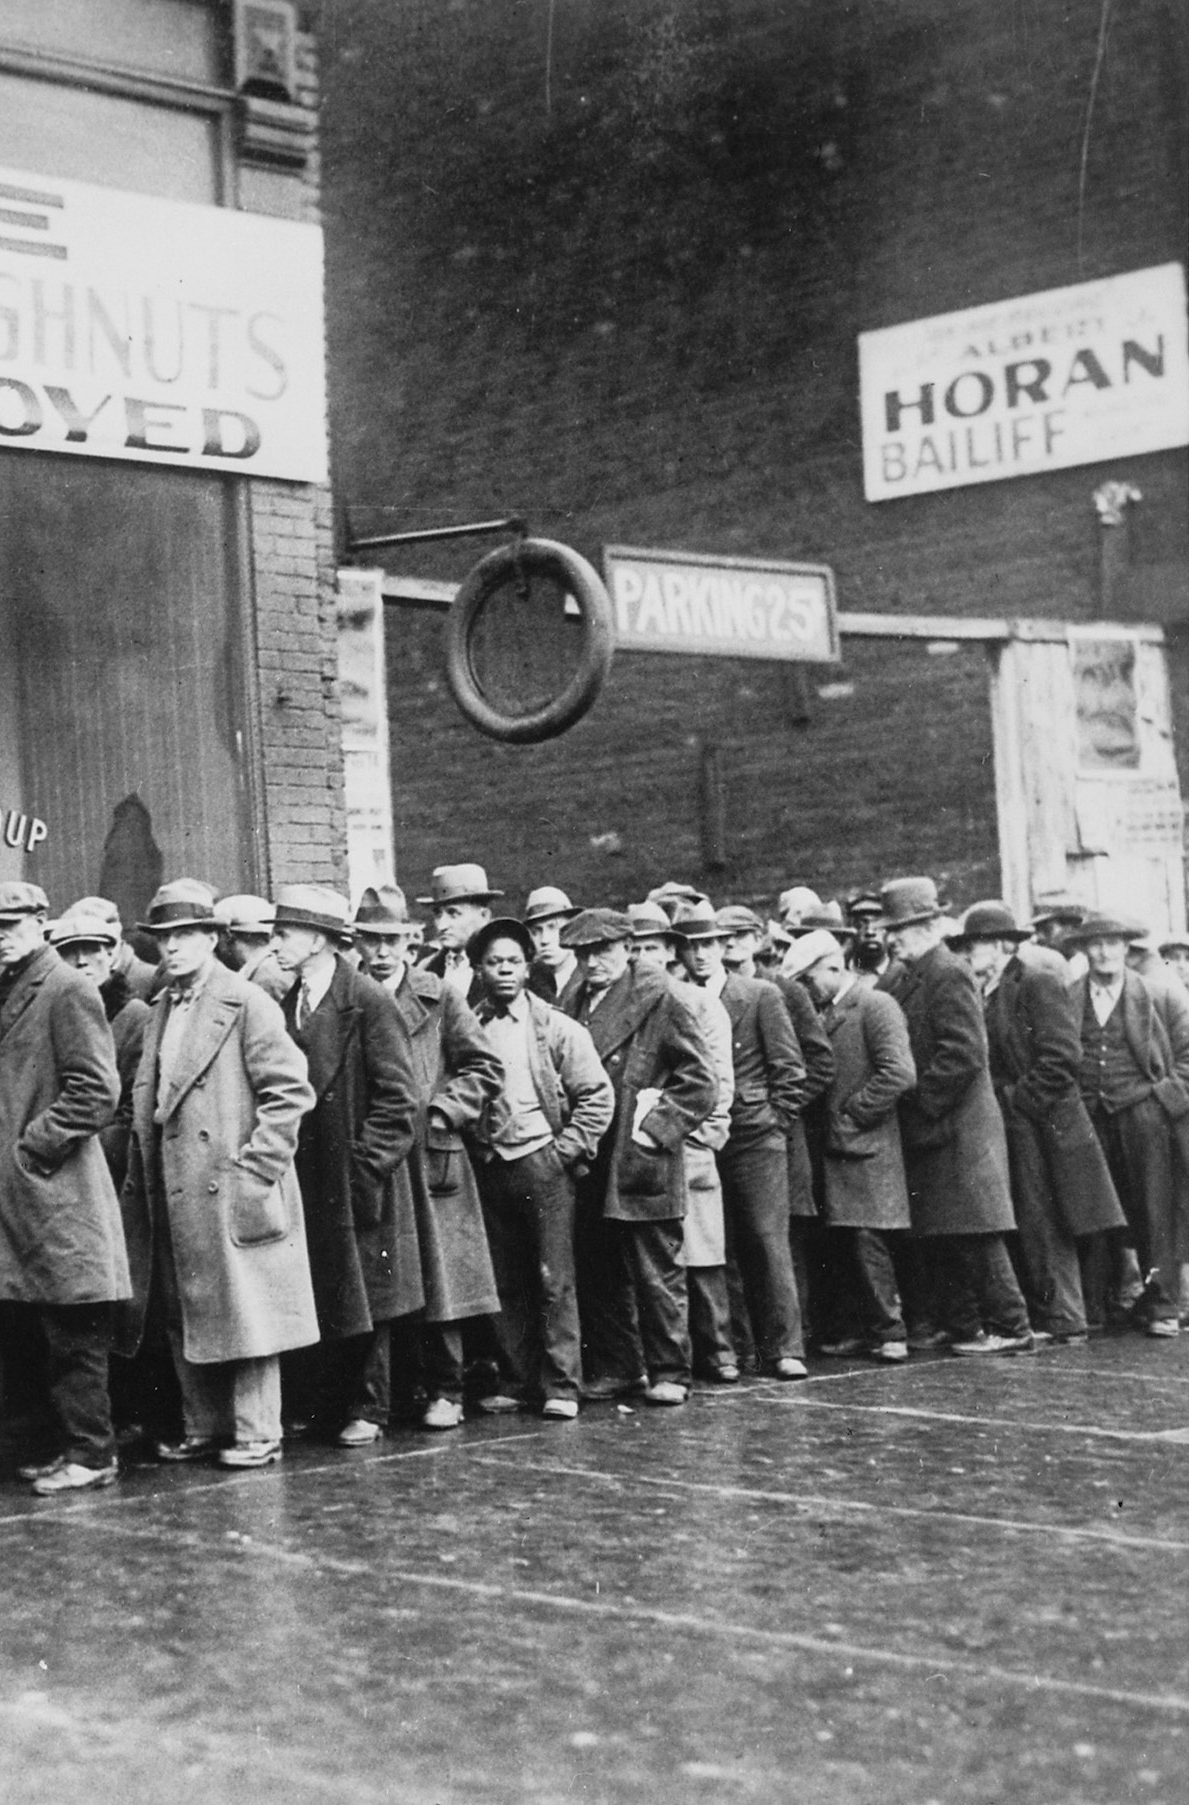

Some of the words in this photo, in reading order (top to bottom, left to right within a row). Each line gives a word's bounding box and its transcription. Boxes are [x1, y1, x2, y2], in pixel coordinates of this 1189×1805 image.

[884, 333, 1165, 433] HORAN
[881, 408, 1066, 483] BAILIFF
[613, 566, 767, 640] PARKING
